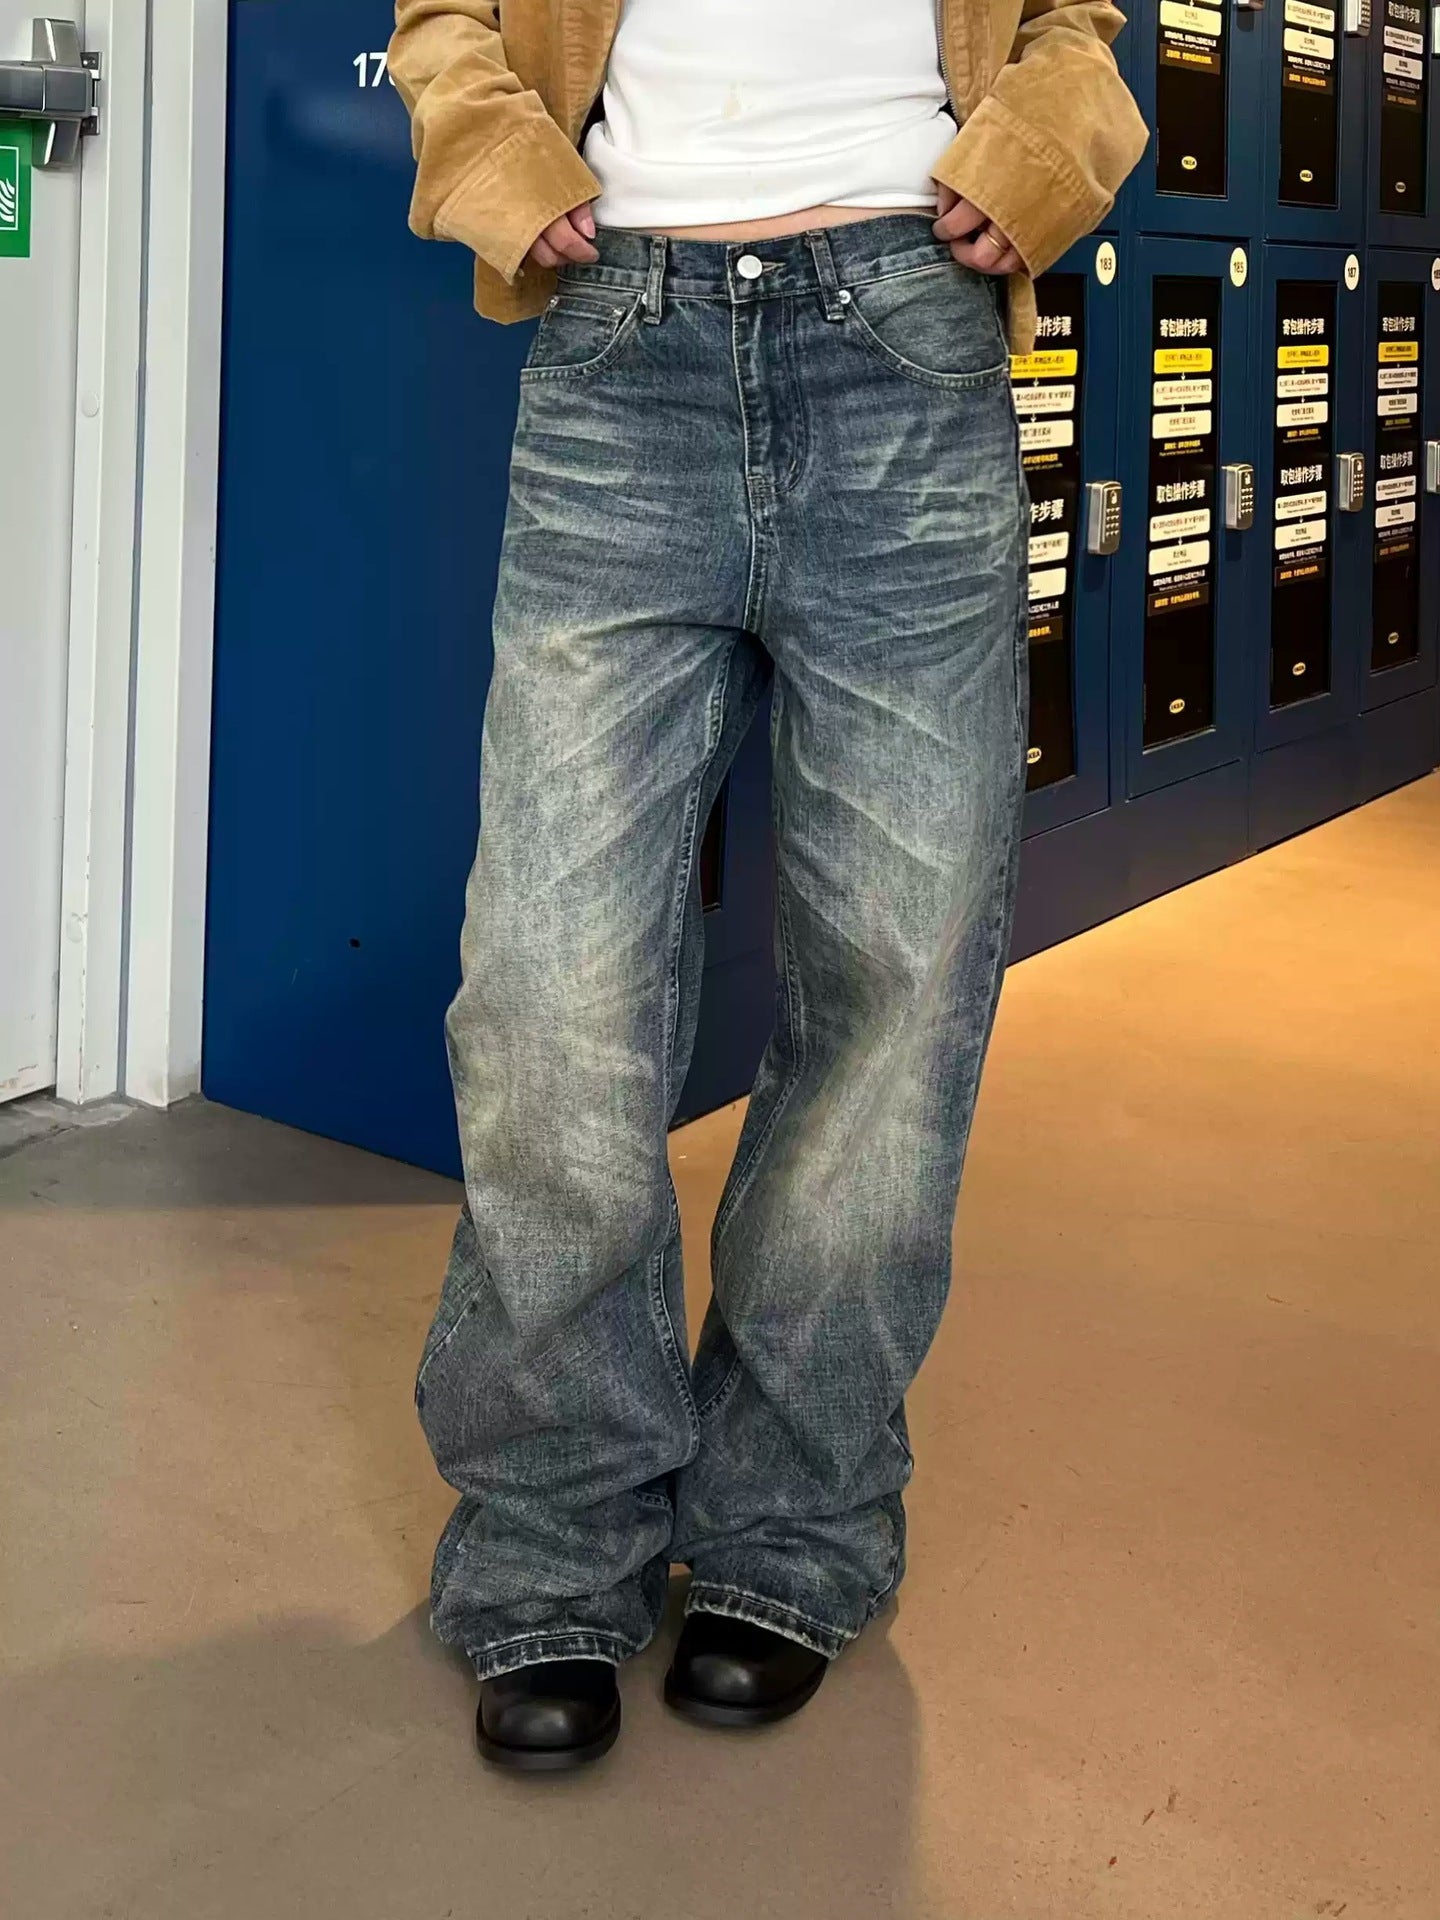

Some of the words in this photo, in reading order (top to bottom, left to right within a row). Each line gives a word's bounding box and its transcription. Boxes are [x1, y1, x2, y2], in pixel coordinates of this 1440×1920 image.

[353, 52, 396, 87] 17
[1100, 257, 1112, 270] 183
[1233, 261, 1244, 273] 185
[1347, 266, 1357, 278] 187
[1160, 318, 1207, 337] 寄包操作步骤
[1282, 318, 1325, 335] 寄包操作步骤
[1280, 464, 1322, 486] 取包操作步骤
[1156, 479, 1205, 504] 取包操作步骤
